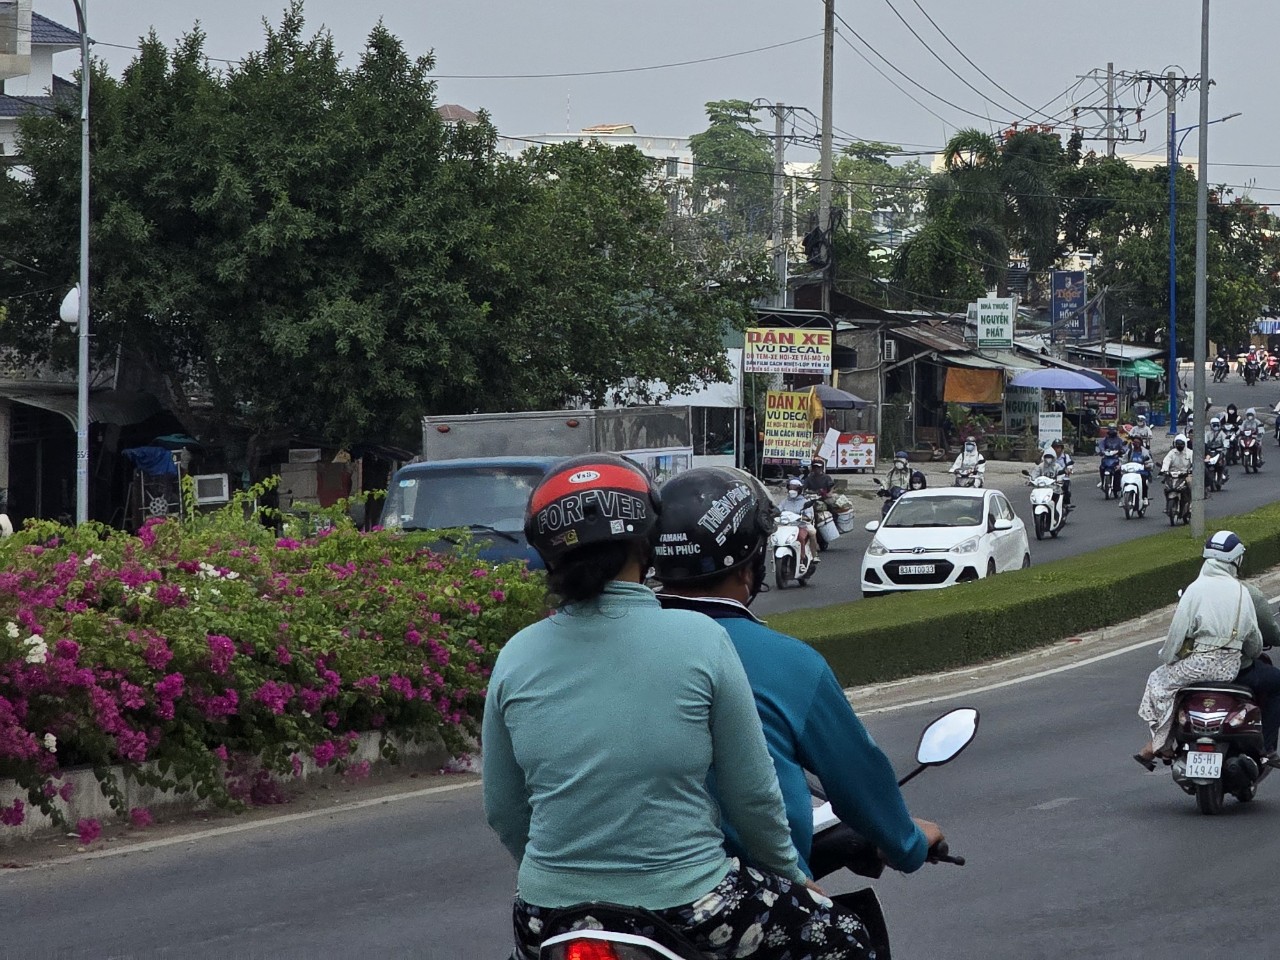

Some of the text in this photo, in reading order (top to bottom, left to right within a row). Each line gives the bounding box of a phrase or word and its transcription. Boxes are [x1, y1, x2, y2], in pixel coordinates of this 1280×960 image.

[1056, 289, 1081, 302] Tiger
[986, 326, 1004, 338] PHÁT
[802, 333, 830, 345] XE
[768, 393, 793, 409] DÁN
[783, 411, 808, 421] DECA
[780, 429, 795, 437] CÁCH
[796, 430, 812, 439] NHIỆT
[538, 490, 646, 534] FOREVER
[675, 542, 701, 556] PHÚC
[1192, 754, 1217, 764] 65-H1
[1188, 765, 1219, 777] 149.49
